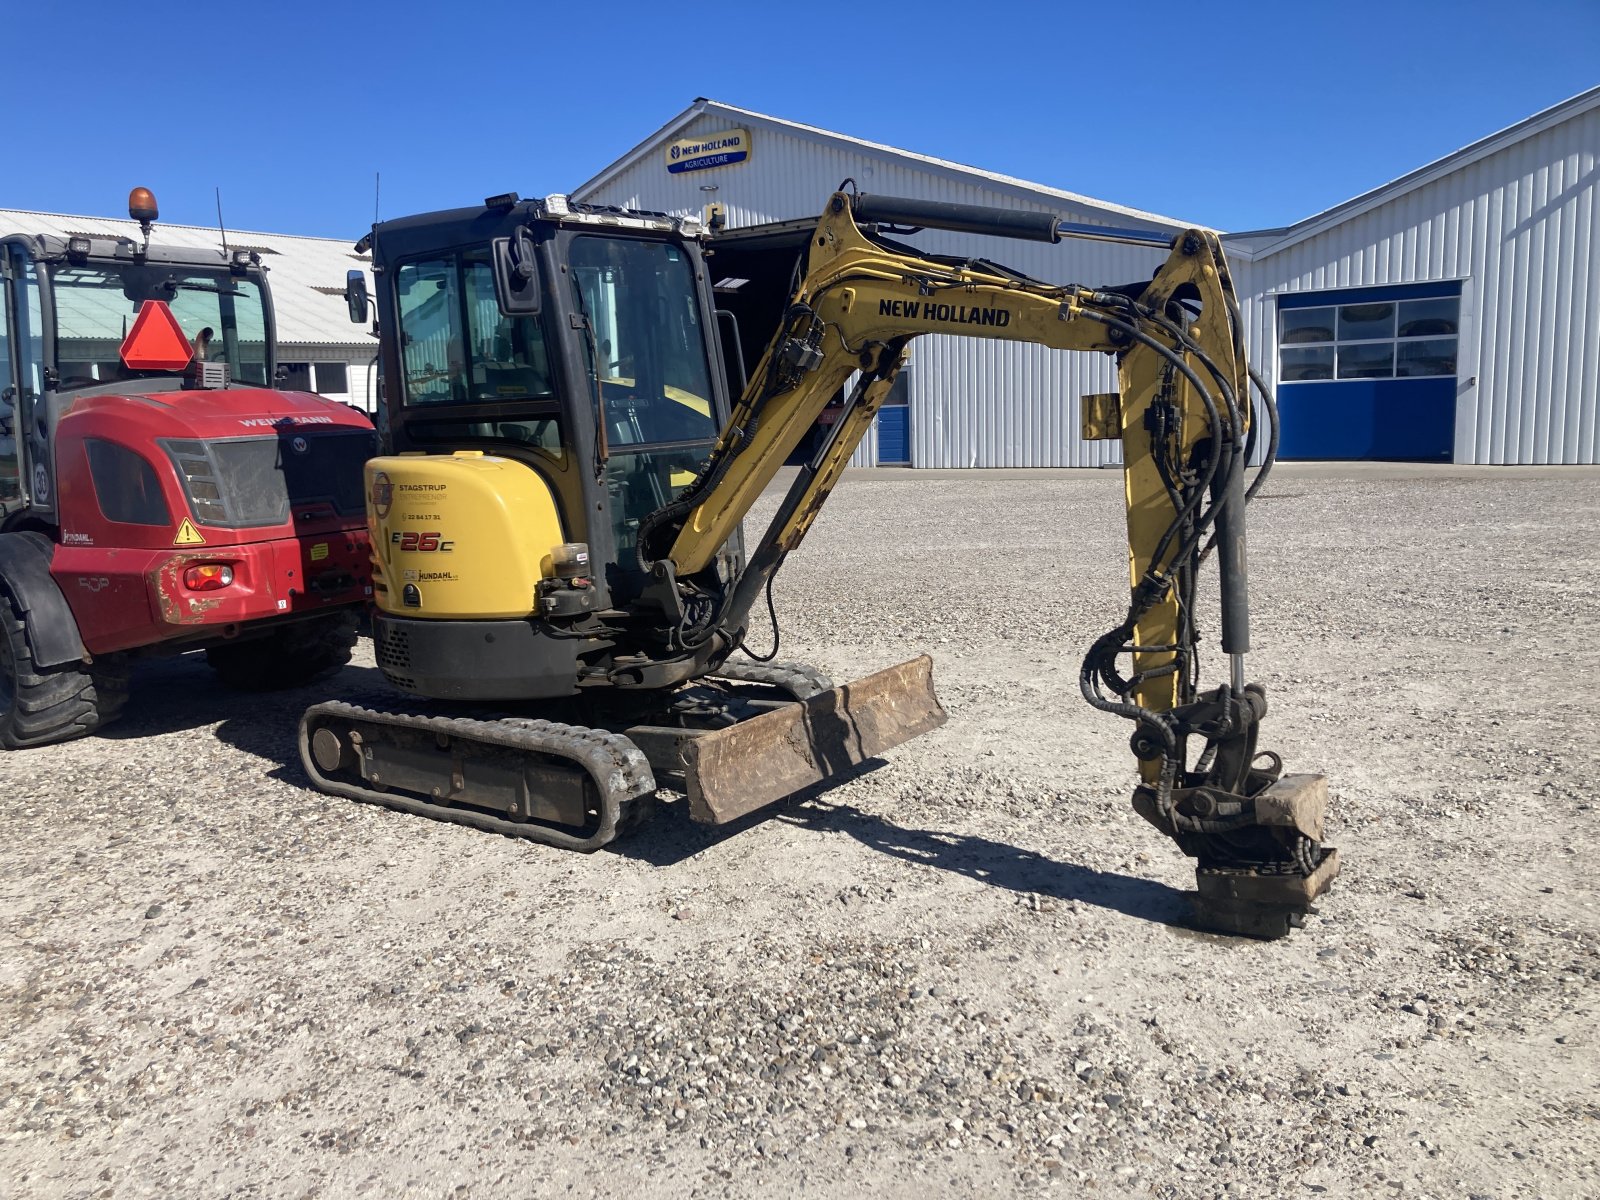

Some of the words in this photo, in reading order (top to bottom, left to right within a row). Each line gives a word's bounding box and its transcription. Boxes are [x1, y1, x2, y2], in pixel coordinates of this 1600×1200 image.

[682, 145, 701, 156] NEW
[701, 137, 740, 153] HOLLAND
[684, 154, 728, 169] AGRICULTURE
[879, 298, 920, 319] NEW
[923, 302, 1010, 328] HOLLAND
